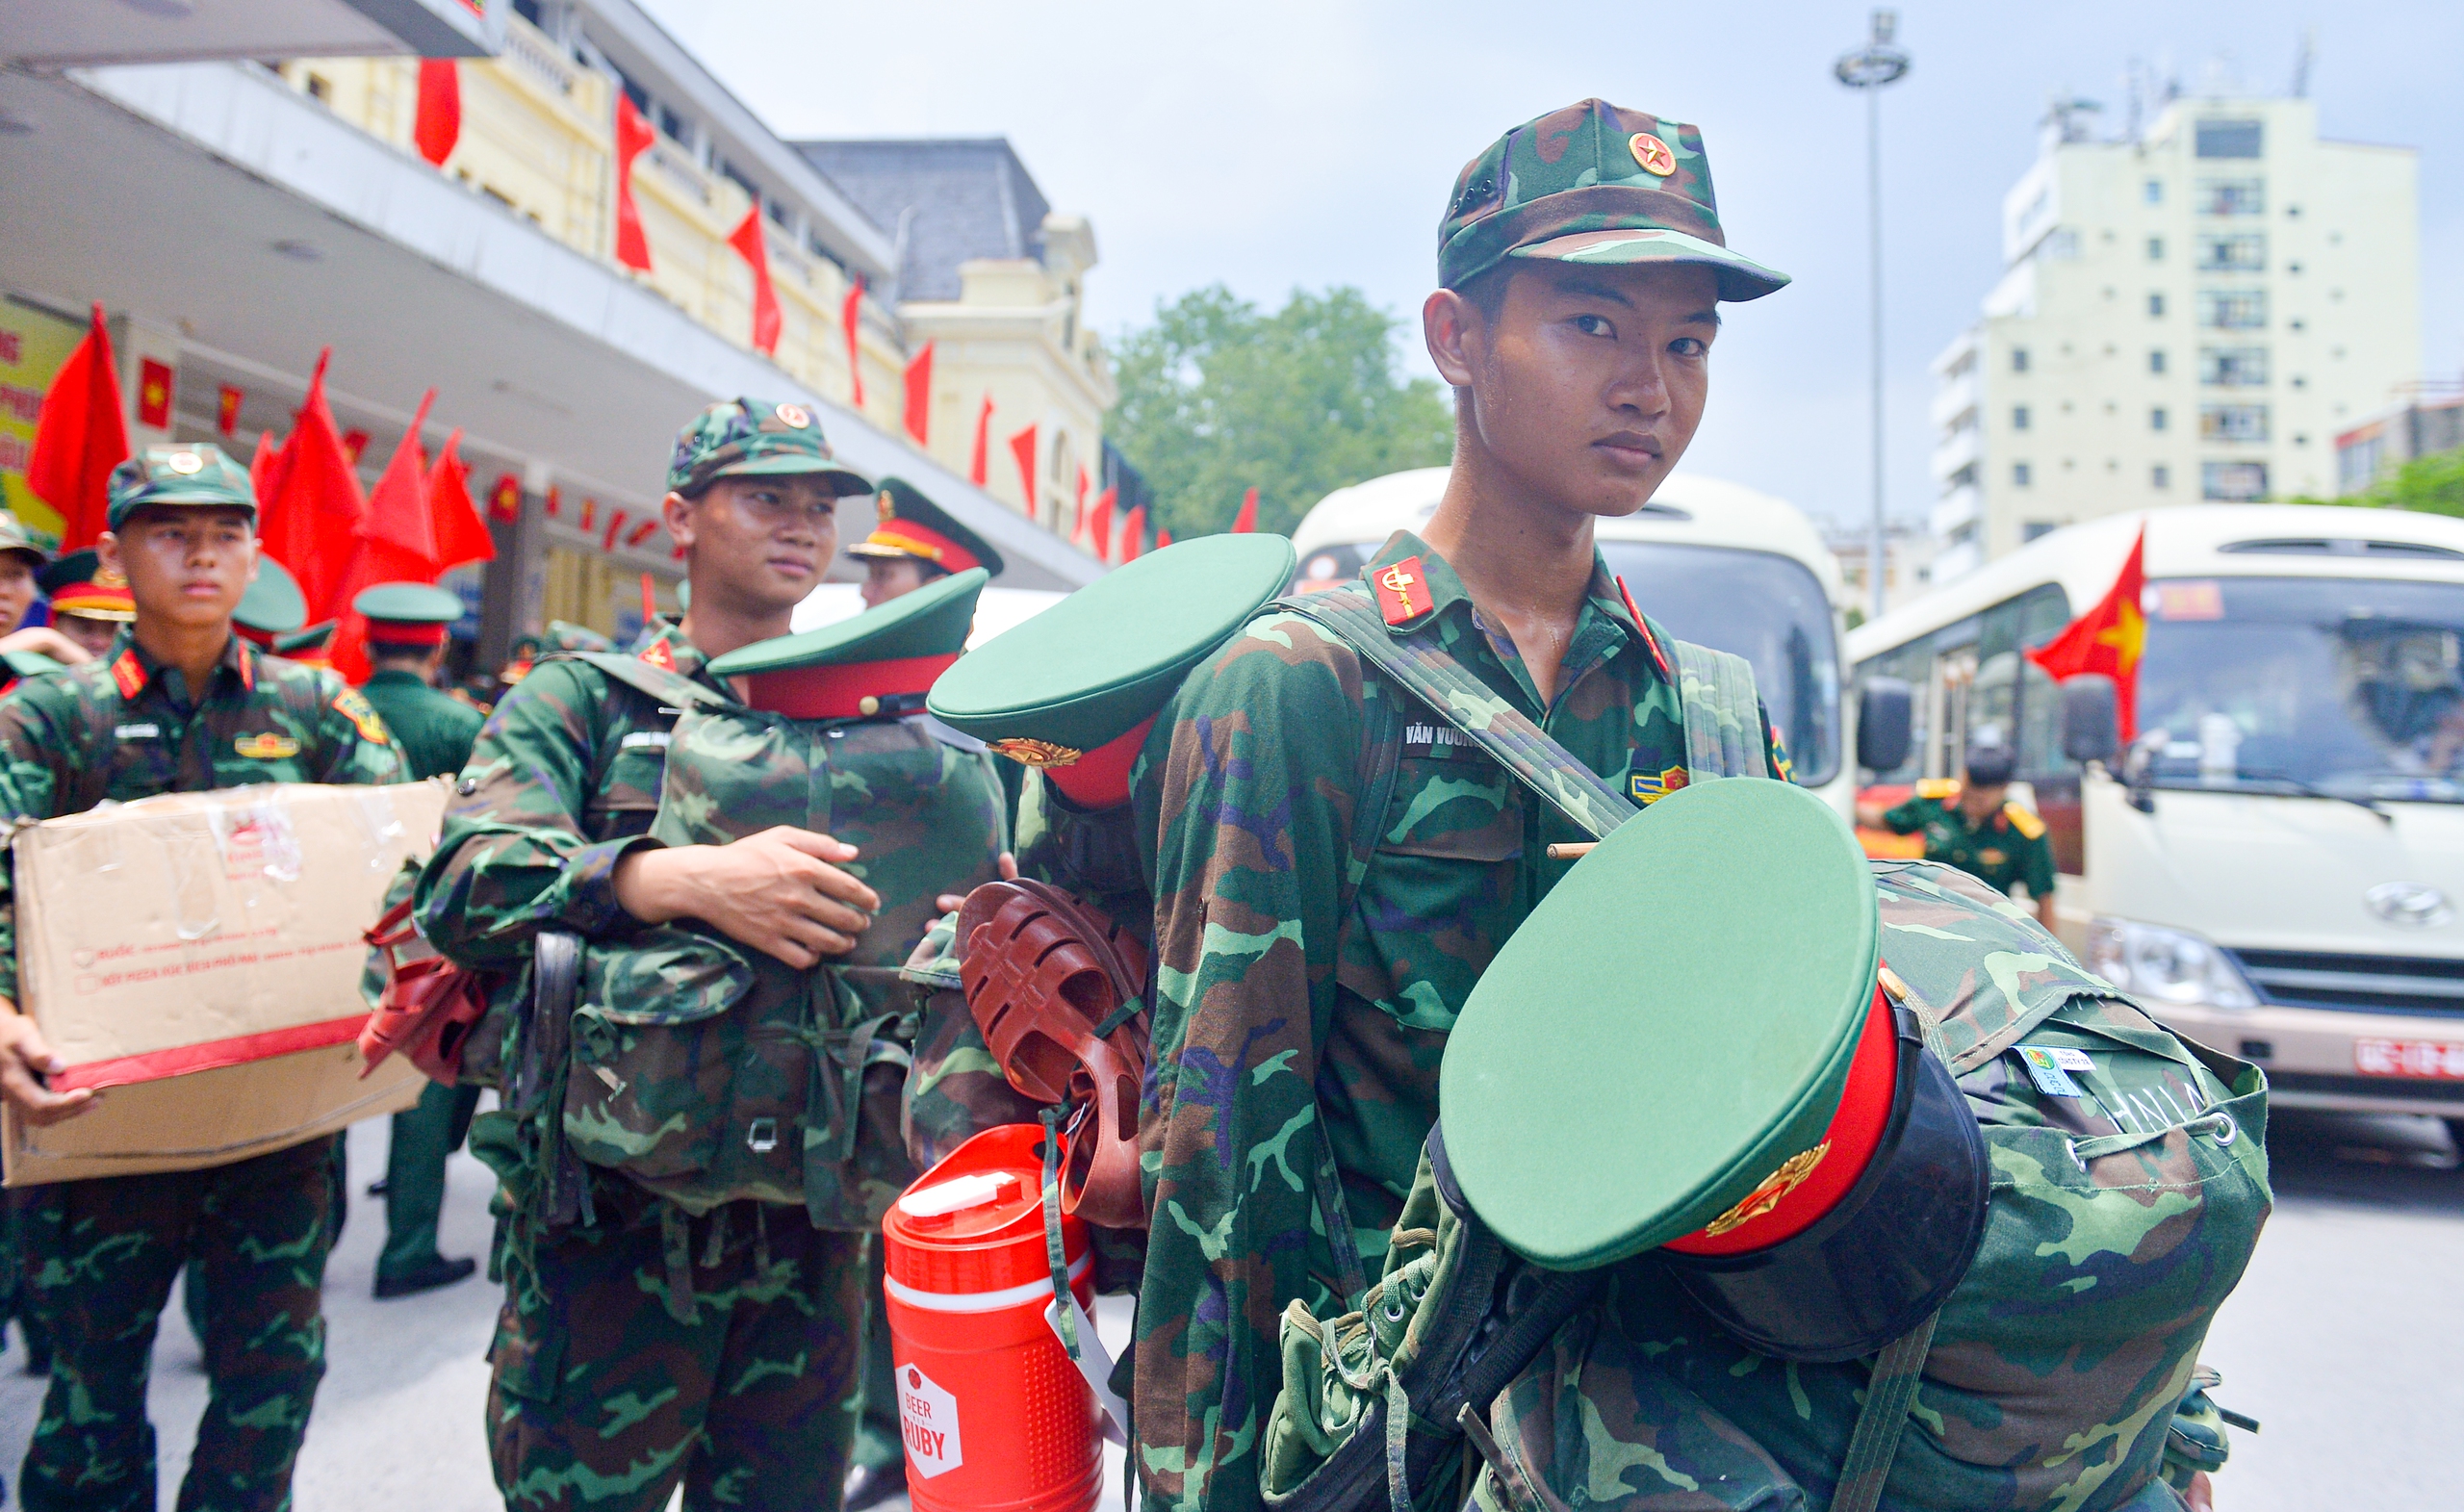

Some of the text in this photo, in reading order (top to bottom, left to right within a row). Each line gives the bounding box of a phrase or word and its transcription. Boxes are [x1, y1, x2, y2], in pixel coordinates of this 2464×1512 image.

[1405, 721, 1434, 744] VĂN
[905, 1392, 933, 1421] BEER
[903, 1414, 945, 1461] RUBY
